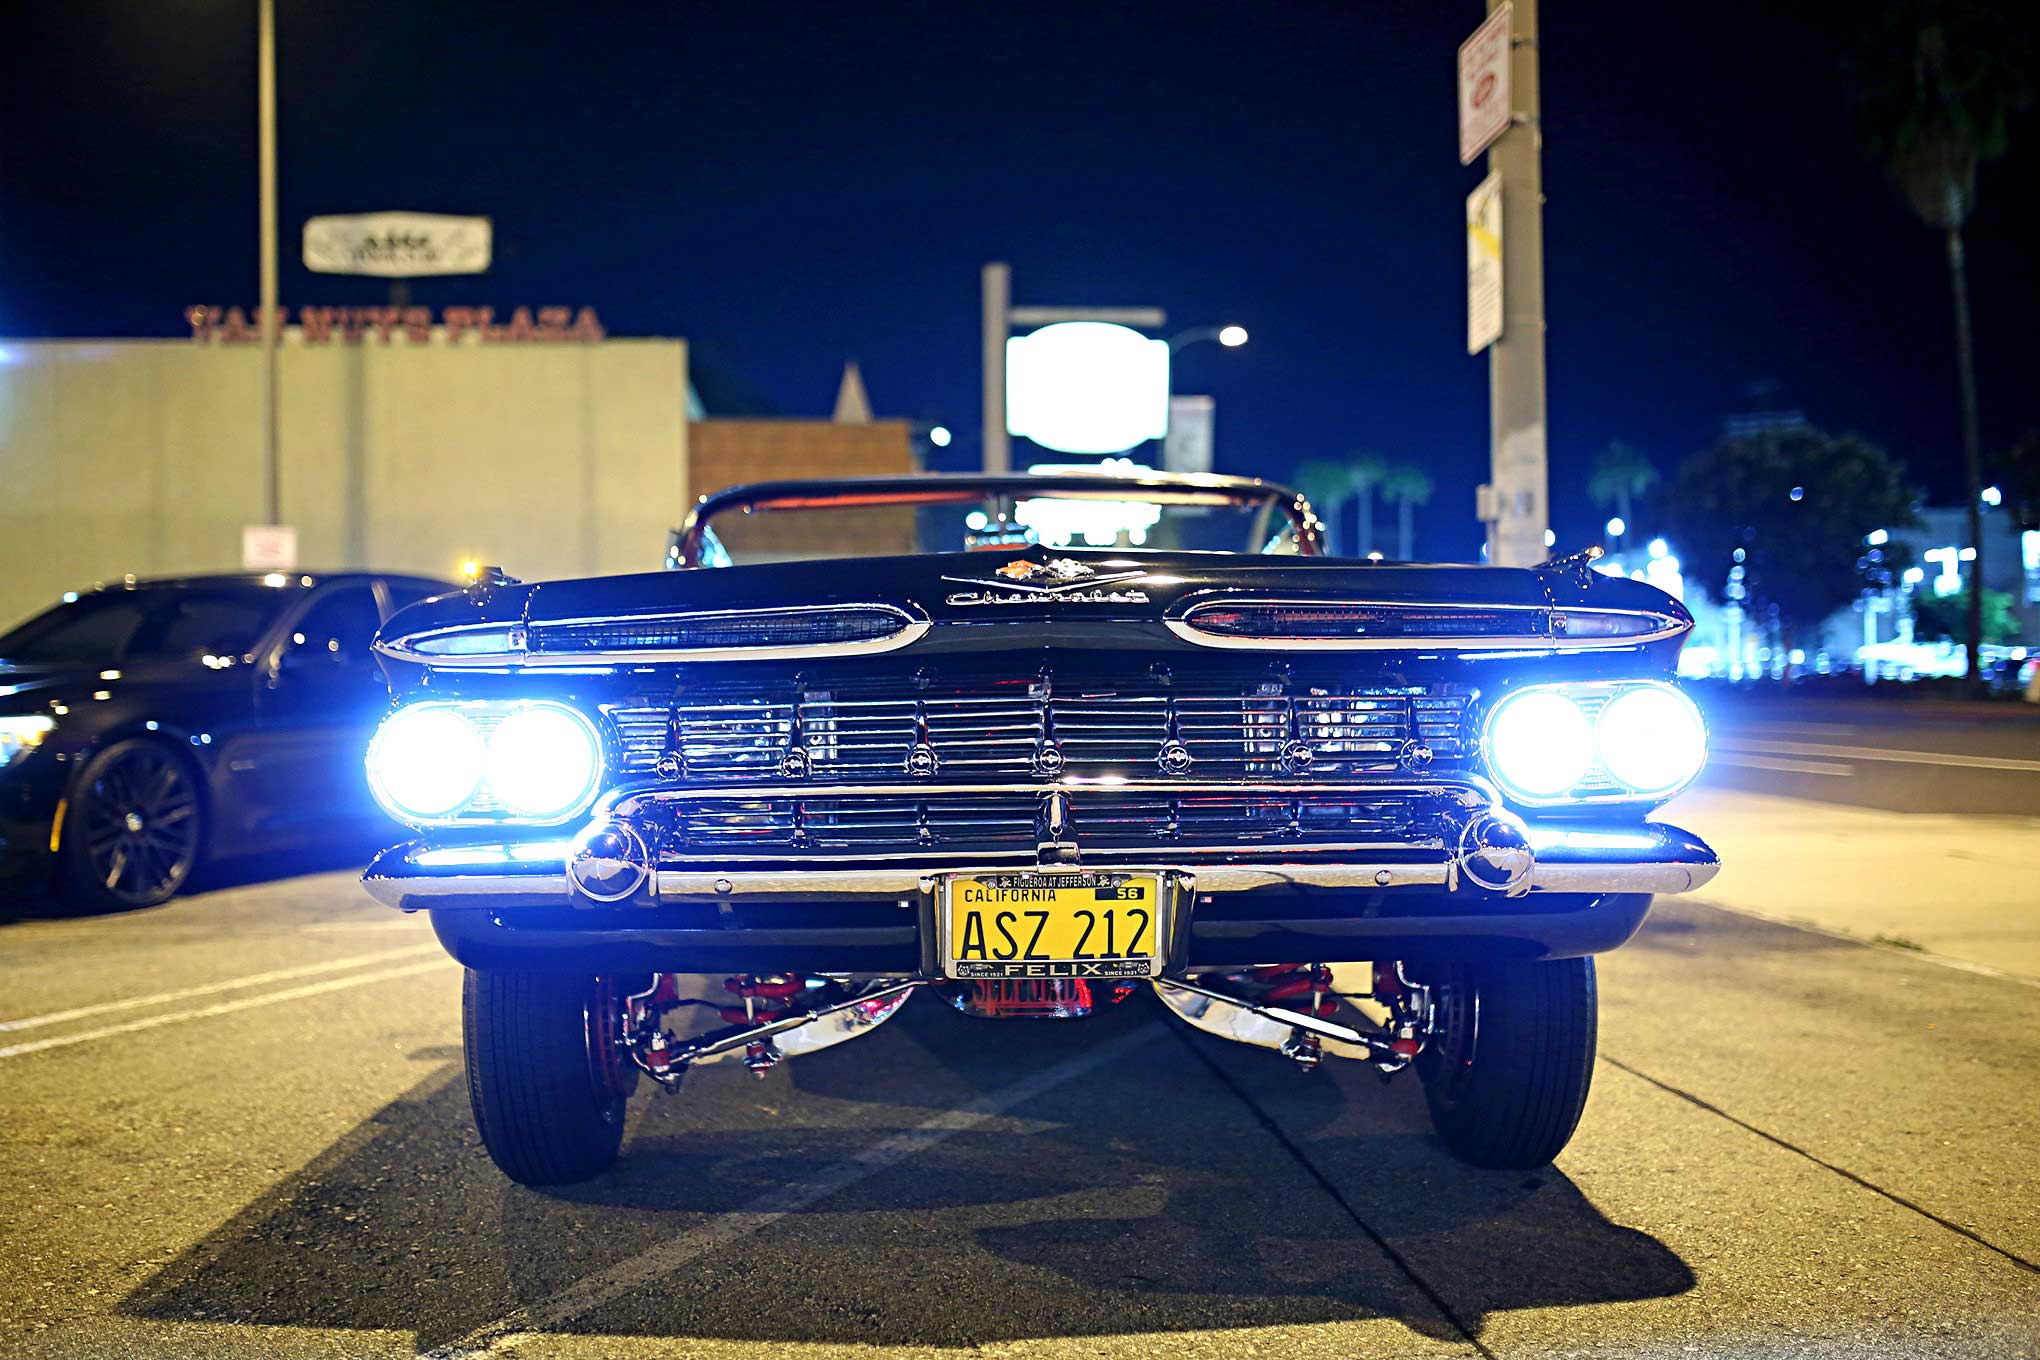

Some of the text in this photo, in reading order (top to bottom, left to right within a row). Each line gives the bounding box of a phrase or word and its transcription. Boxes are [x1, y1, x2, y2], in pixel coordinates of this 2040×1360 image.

[443, 305, 603, 343] PLAZA
[1013, 875, 1096, 888] FIGUEROA AT JEFFERSON
[965, 889, 1057, 903] CALIFORNIA
[1117, 888, 1139, 899] 56
[961, 909, 1149, 960] ASZ 212
[1005, 964, 1103, 976] FELIX
